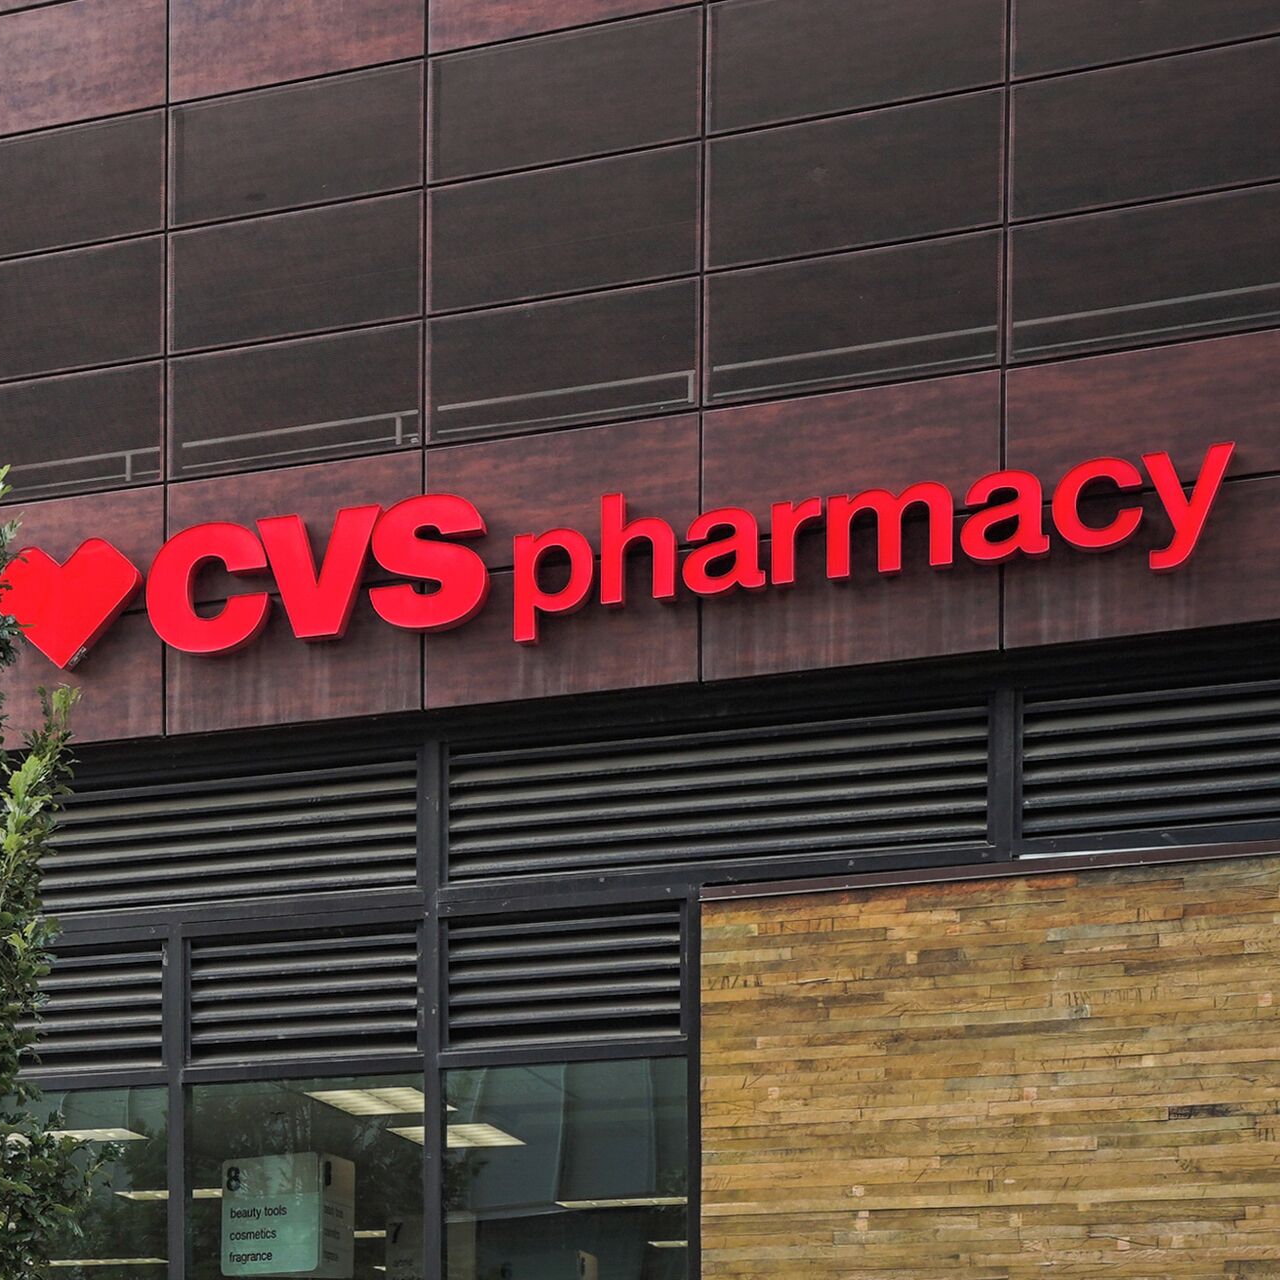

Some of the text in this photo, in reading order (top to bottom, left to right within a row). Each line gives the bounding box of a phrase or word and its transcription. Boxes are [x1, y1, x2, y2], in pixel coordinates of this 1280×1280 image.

[145, 441, 1236, 655] CVS pharmacy
[226, 1166, 241, 1192] 8
[230, 1205, 287, 1220] beauty tools
[229, 1228, 277, 1241] cosmetics
[389, 1222, 403, 1244] 7
[229, 1251, 273, 1264] fragrance
